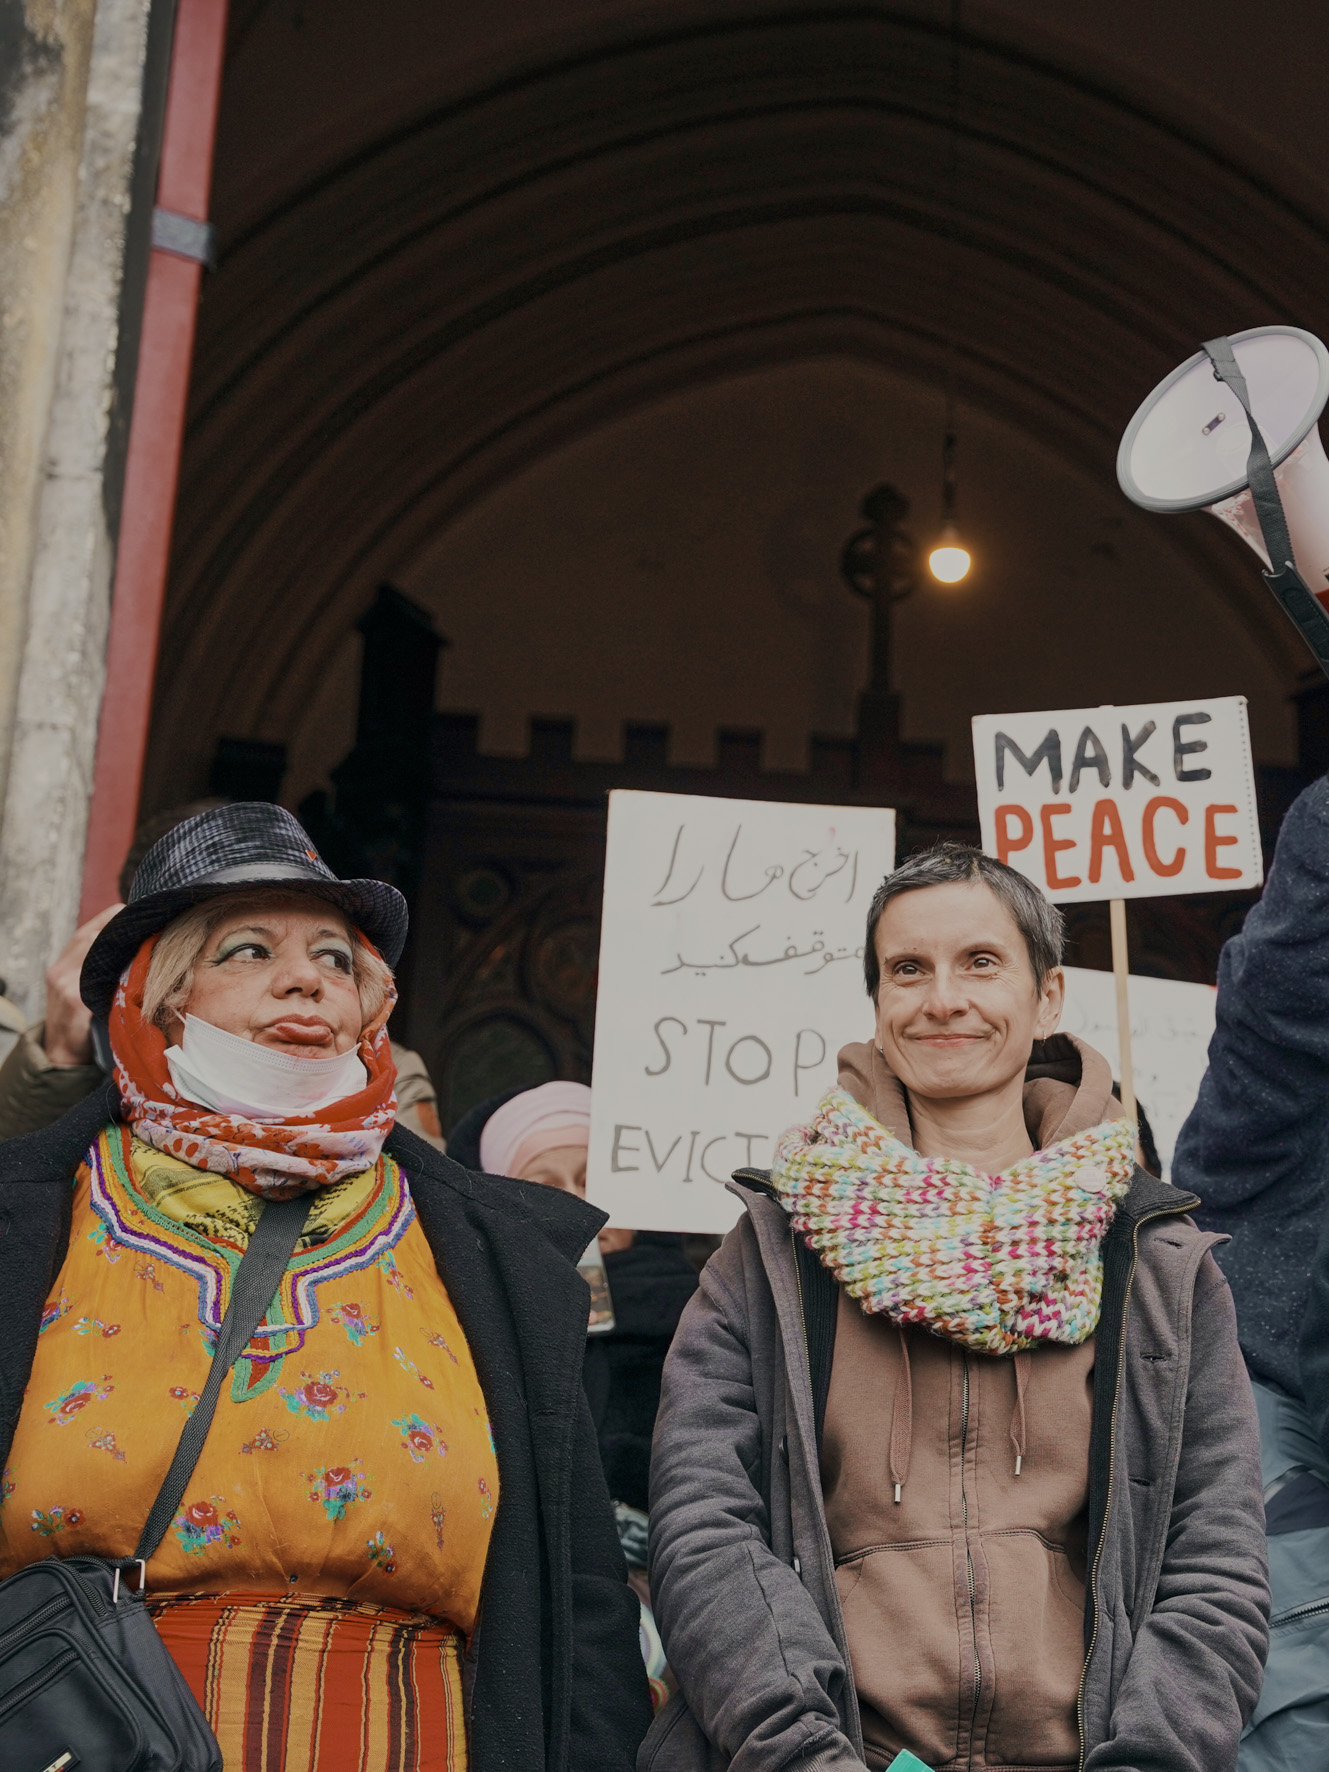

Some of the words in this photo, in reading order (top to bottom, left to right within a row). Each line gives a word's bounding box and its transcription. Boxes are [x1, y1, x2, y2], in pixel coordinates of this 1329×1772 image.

[994, 711, 1212, 795] MAKE
[994, 796, 1243, 890] PEACE
[644, 1016, 827, 1097] STOP
